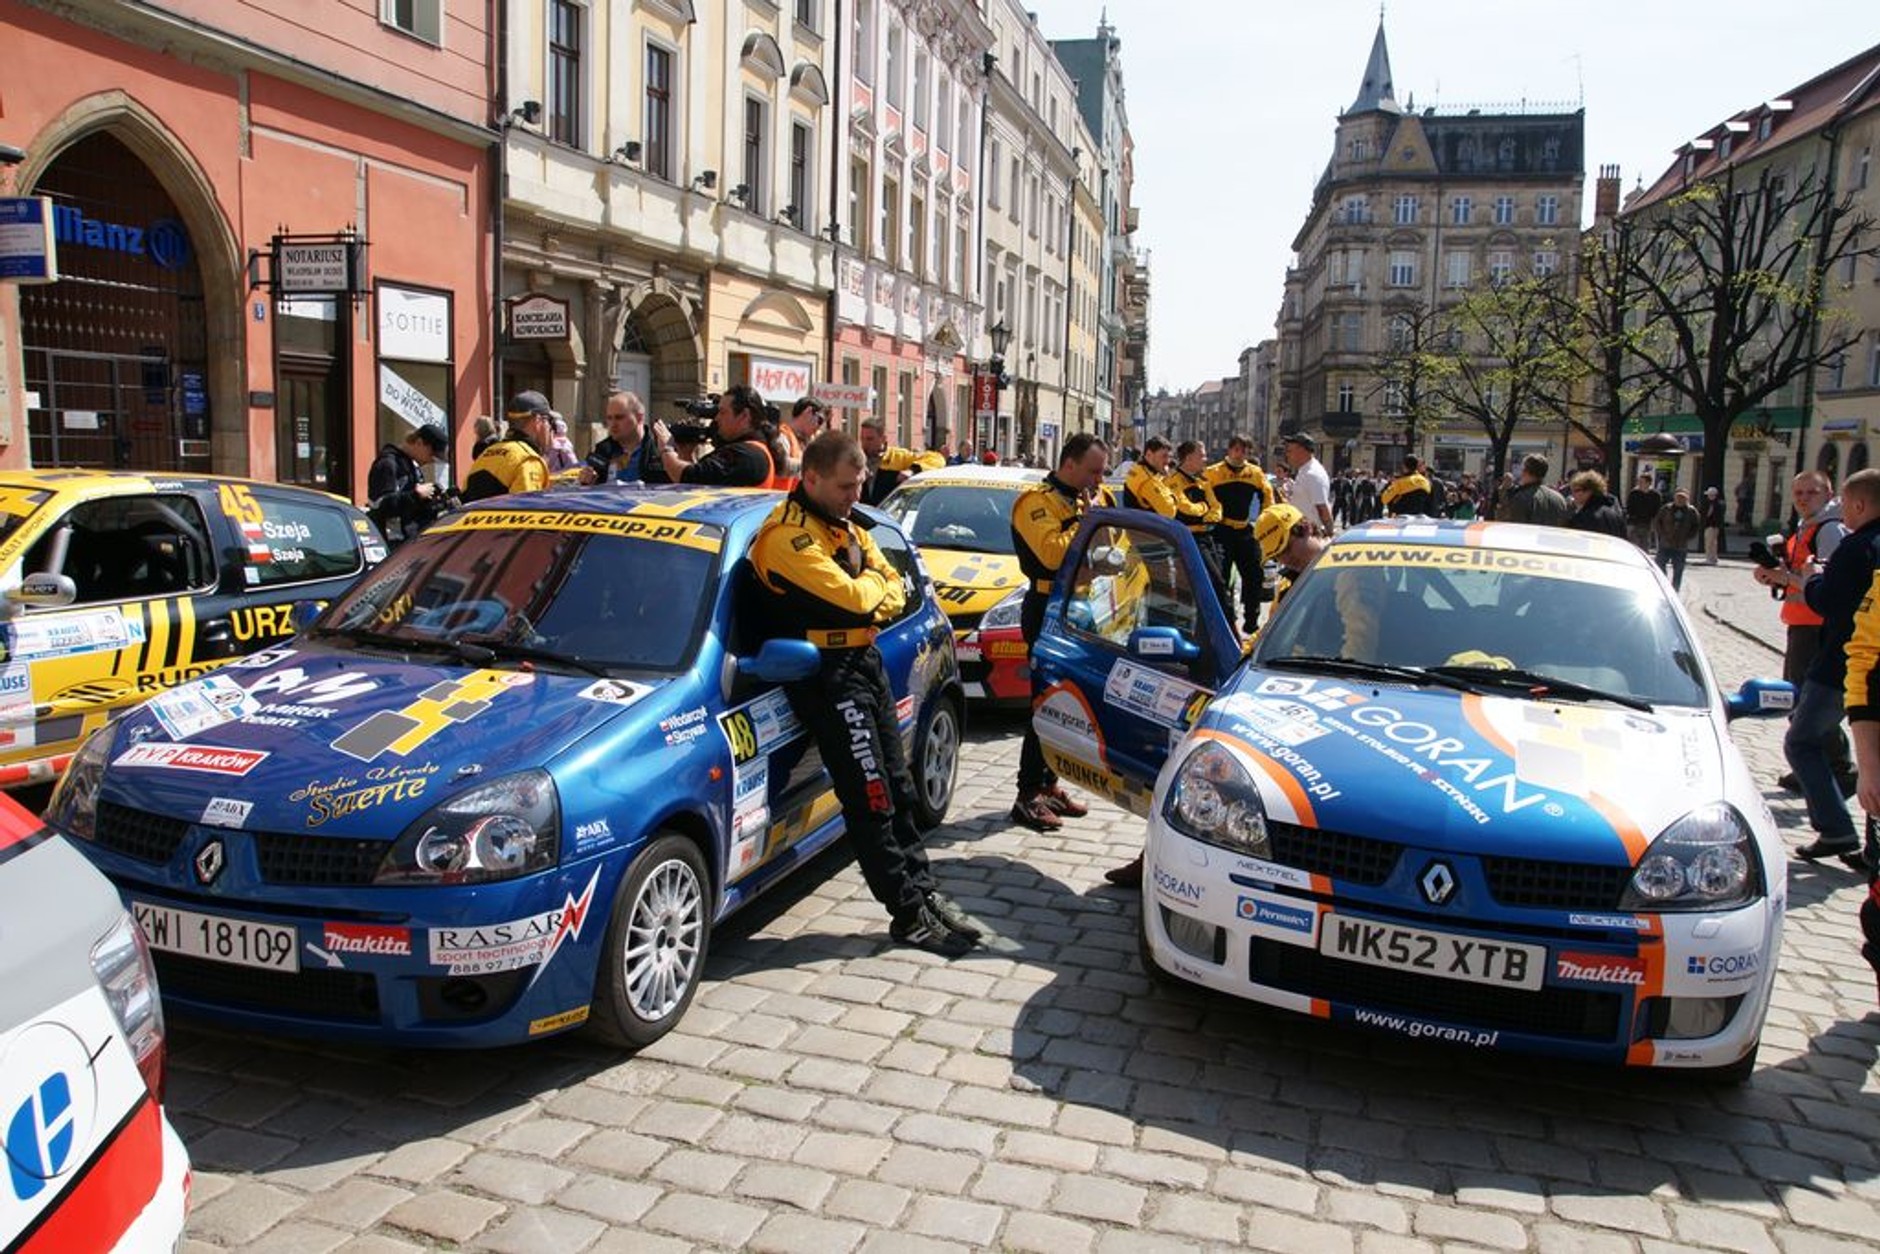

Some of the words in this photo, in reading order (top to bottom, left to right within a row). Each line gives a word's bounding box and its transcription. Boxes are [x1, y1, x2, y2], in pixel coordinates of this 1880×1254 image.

[286, 249, 343, 263] NOTARIUSZ
[385, 312, 443, 336] SOTTIE
[384, 383, 400, 401] DO
[218, 484, 264, 526] 45
[261, 520, 311, 543] Szeja
[461, 511, 688, 540] www.cliocup.pl
[272, 548, 305, 564] Szeja
[726, 712, 757, 761] 48
[176, 750, 256, 769] KRAKÓW
[1231, 723, 1342, 801] www.goran.pl
[1351, 706, 1547, 814] GORAN
[306, 776, 428, 828] Suerte
[134, 905, 181, 949] KWI
[199, 918, 292, 966] 18109
[437, 951, 475, 965] sport
[1337, 920, 1438, 969] WK52
[1449, 940, 1529, 983] XTB
[453, 963, 481, 975] 888
[1354, 1008, 1499, 1047] www.goran.pl
